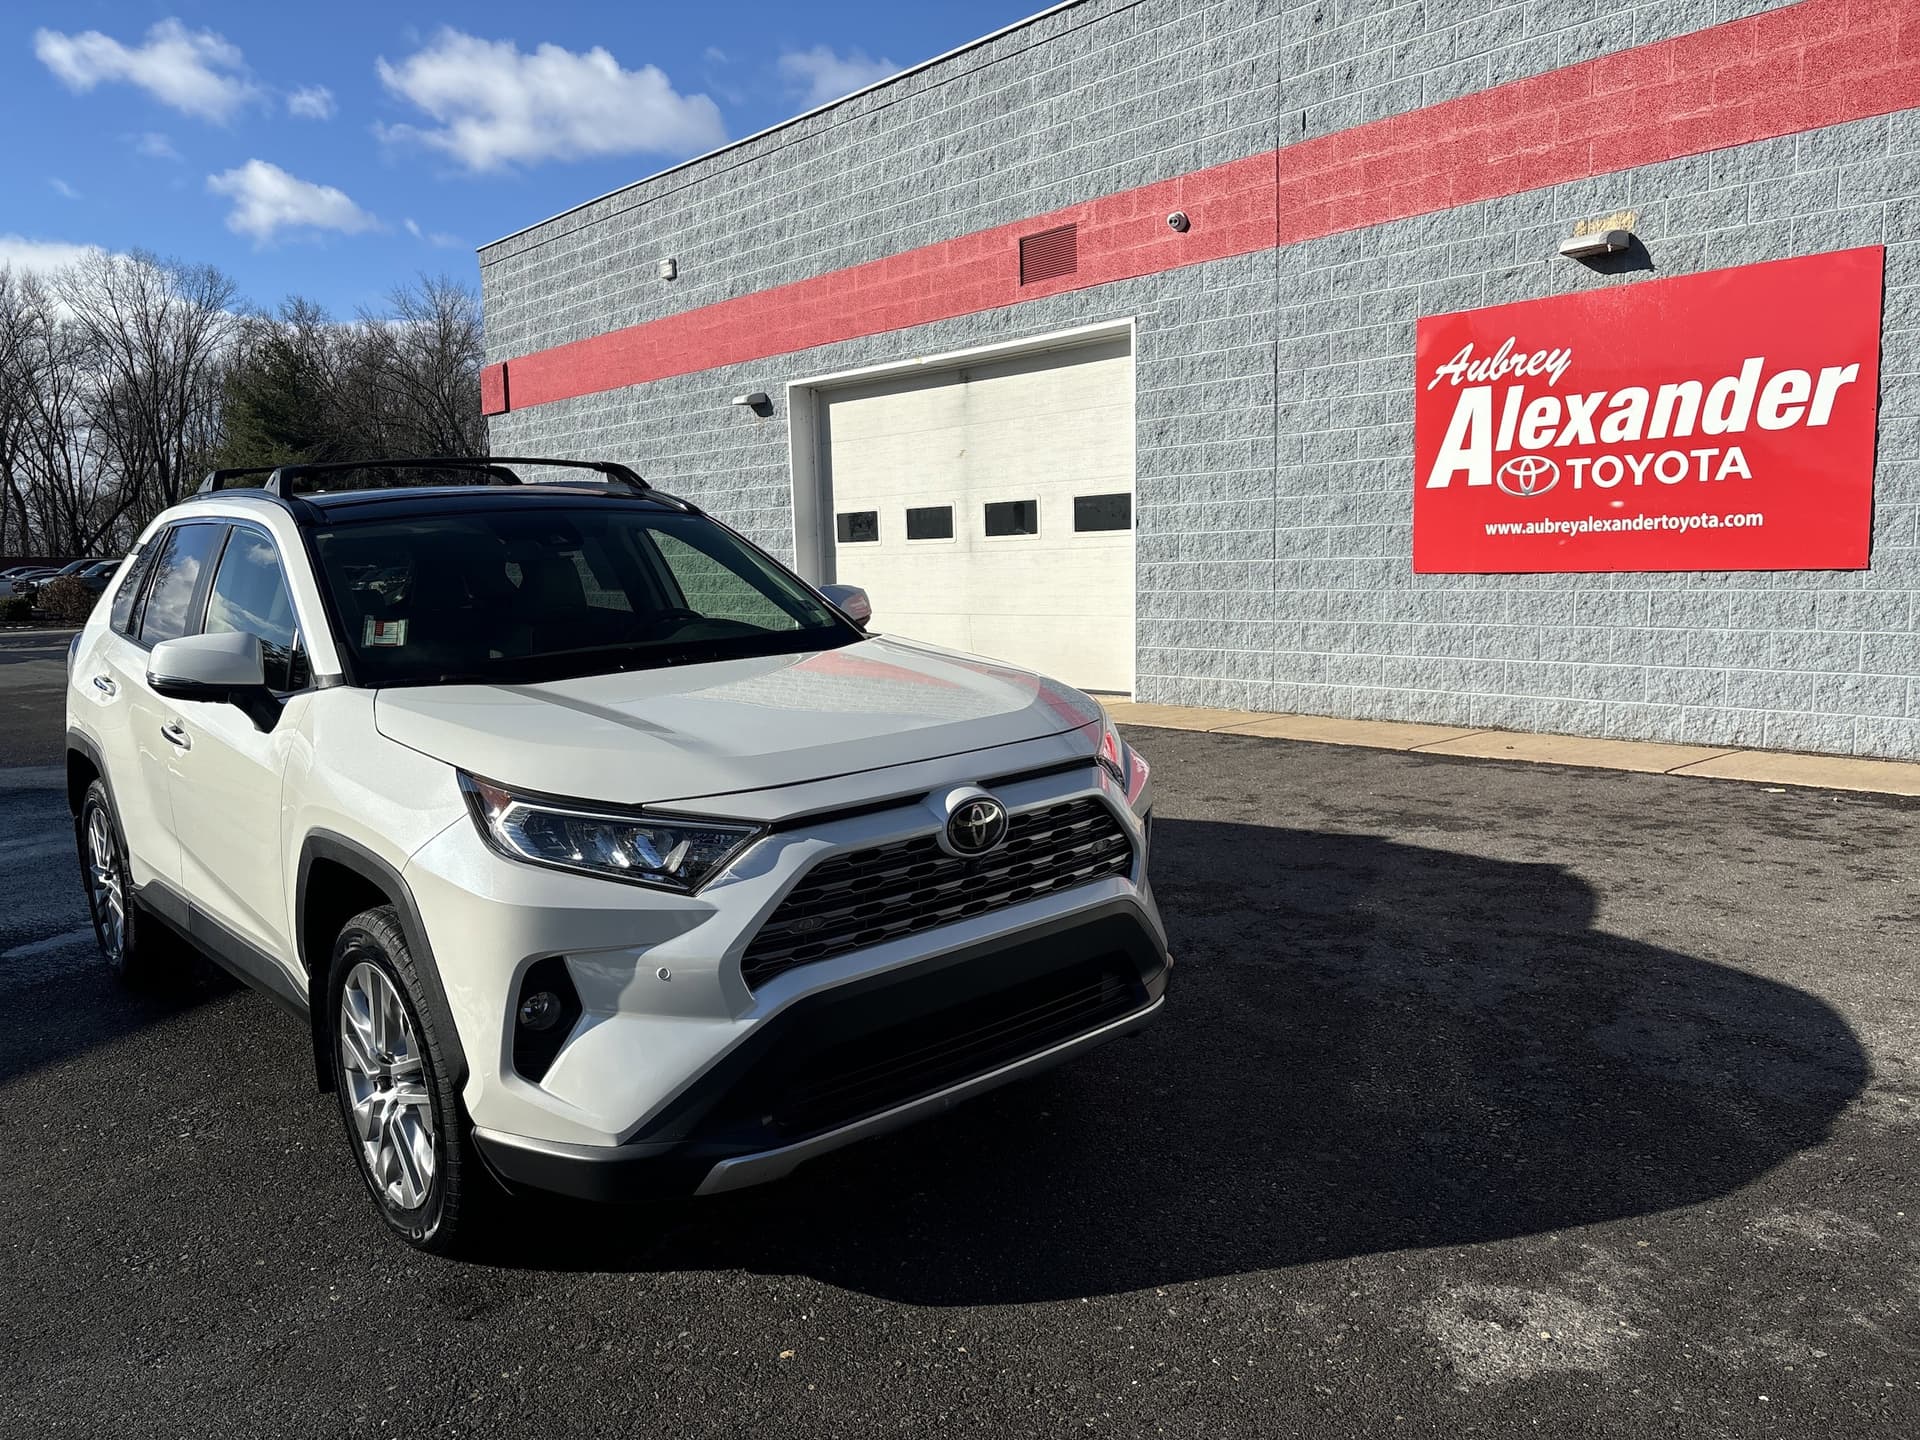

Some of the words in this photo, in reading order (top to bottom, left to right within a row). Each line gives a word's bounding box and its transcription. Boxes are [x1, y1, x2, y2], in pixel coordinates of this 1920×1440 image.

[1427, 336, 1572, 391] Aubrey
[1426, 356, 1860, 490] Alexander
[1566, 446, 1753, 490] TOYOTA
[1484, 511, 1765, 537] www.aubreyalexandertoyota.com
